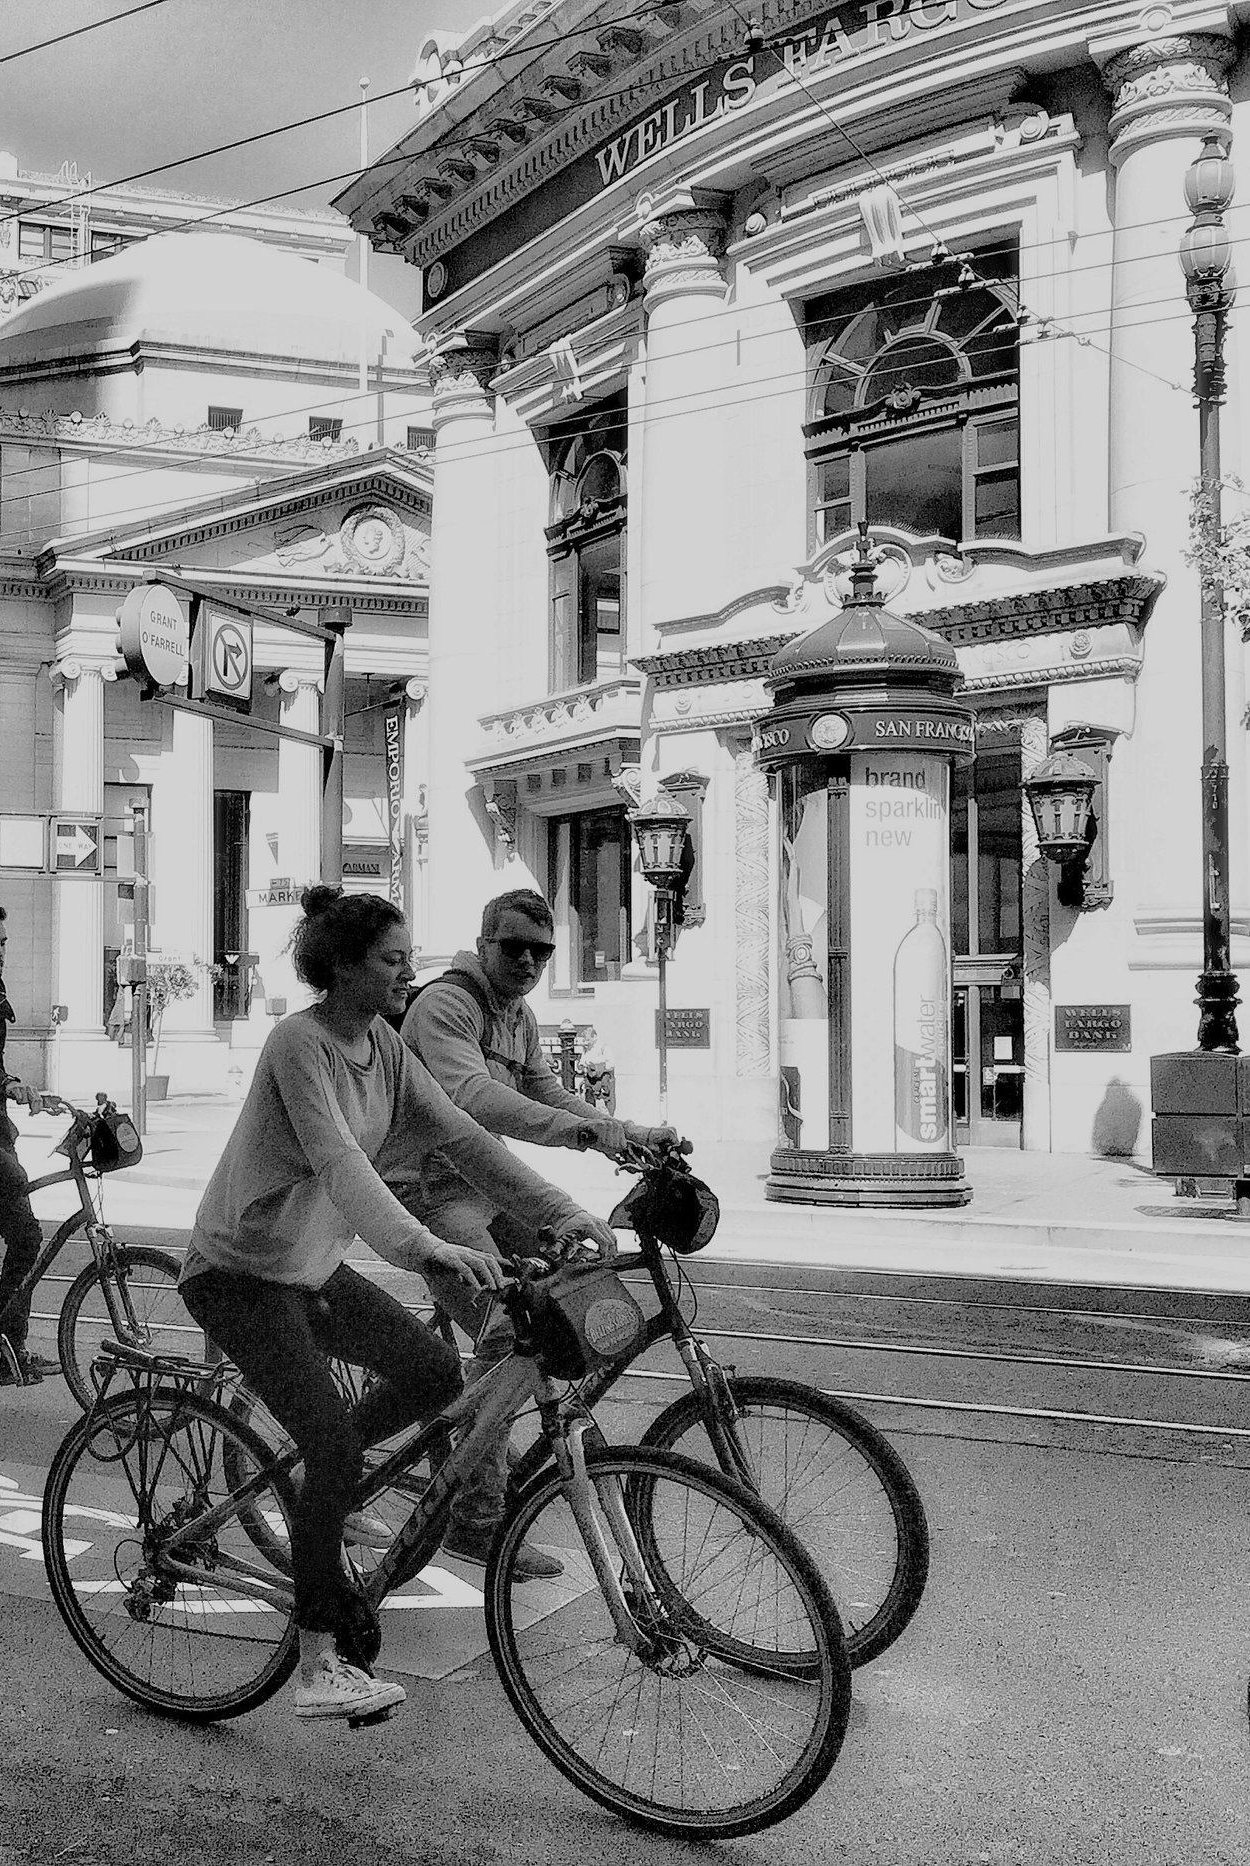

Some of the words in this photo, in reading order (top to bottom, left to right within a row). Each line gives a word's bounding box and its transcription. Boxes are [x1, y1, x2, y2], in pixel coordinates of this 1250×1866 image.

[595, 57, 756, 186] WELLS
[777, 0, 1002, 88] FARG
[150, 610, 178, 630] GRANT
[142, 631, 185, 657] O'FARRELL
[875, 720, 911, 738] SAN
[385, 715, 400, 820] EMPORIO
[865, 767, 926, 789] brand
[865, 829, 912, 847] new
[1064, 1008, 1122, 1017] WELLS
[666, 1021, 704, 1029] ARGO
[1064, 1020, 1123, 1029] FARGO
[1068, 1031, 1118, 1039] BANK
[915, 994, 937, 1140] smartwater
